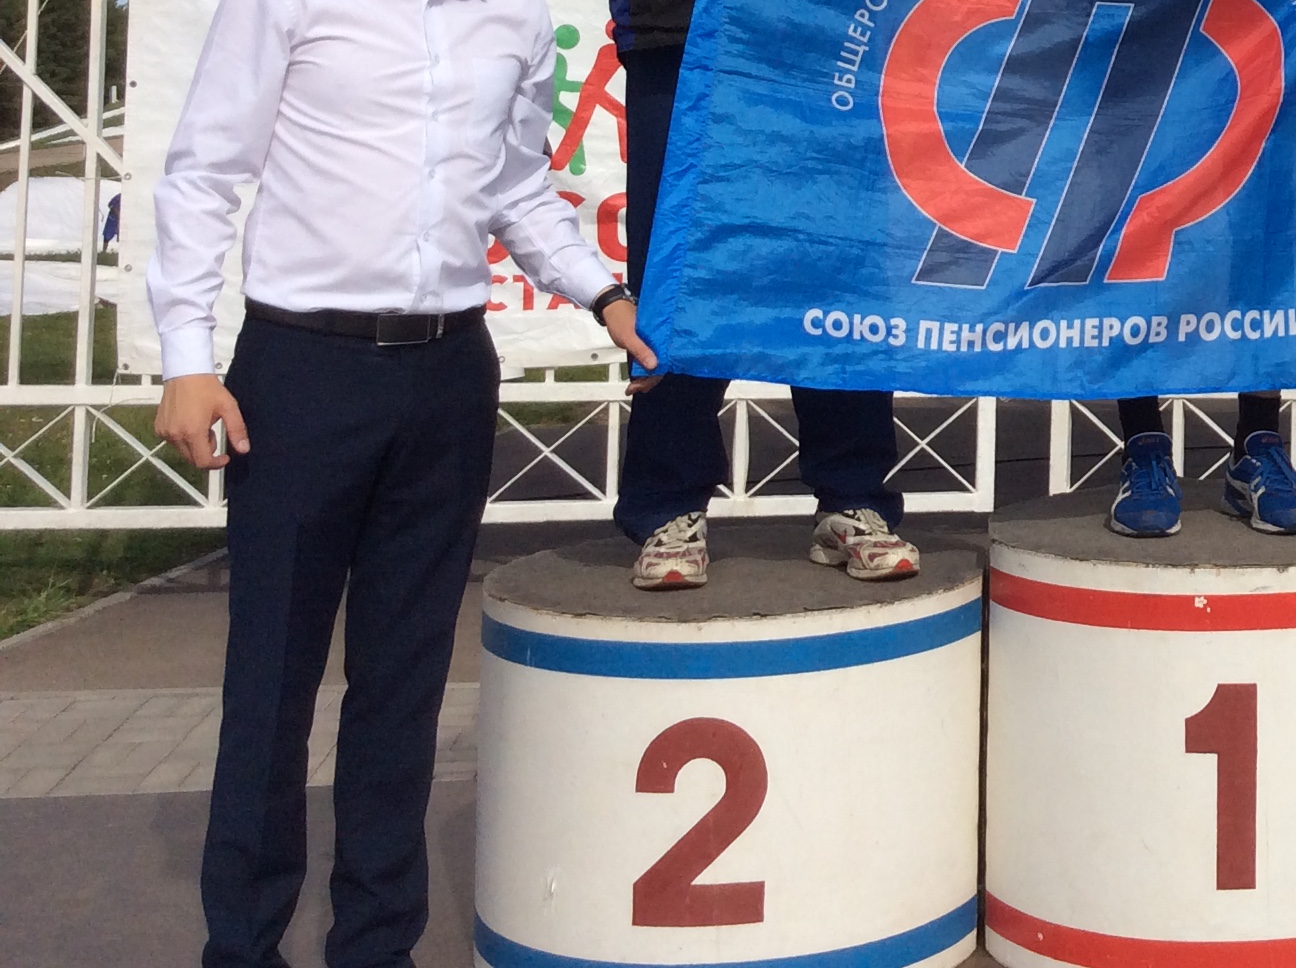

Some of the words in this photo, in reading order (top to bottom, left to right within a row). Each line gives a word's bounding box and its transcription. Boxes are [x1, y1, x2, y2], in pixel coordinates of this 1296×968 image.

[803, 307, 907, 346] СОЮЗ
[916, 315, 1168, 352] ПЕНСИОНЕРОВ
[632, 717, 769, 927] 2
[1184, 683, 1259, 891] 1
